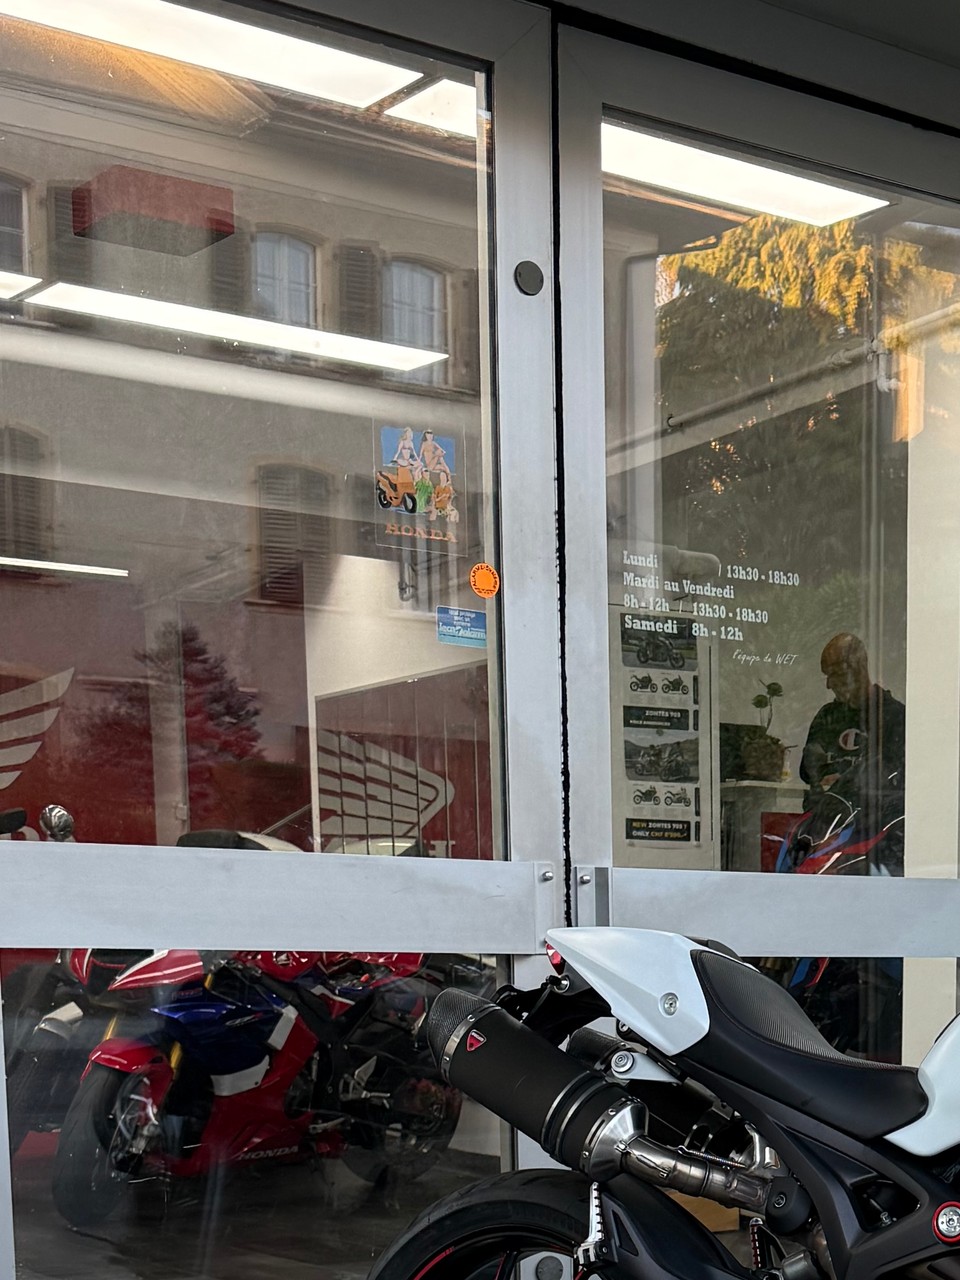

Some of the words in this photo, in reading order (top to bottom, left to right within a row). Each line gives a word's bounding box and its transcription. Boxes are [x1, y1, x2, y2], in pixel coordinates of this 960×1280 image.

[385, 523, 458, 542] HONDA
[623, 551, 658, 568] Lundi
[727, 565, 758, 580] 13h30
[768, 570, 799, 586] 18h30
[623, 572, 659, 589] Mardi
[664, 580, 679, 592] au
[683, 580, 734, 598] Vendredi
[624, 594, 639, 608] 8h
[649, 597, 670, 612] 12h
[692, 602, 726, 618] 13h30
[736, 607, 768, 623] 18h30
[625, 615, 678, 633] Samedi
[692, 623, 708, 637] 8h
[721, 626, 743, 641] 12h
[776, 653, 799, 665] WET
[235, 1146, 299, 1160] HONDA
